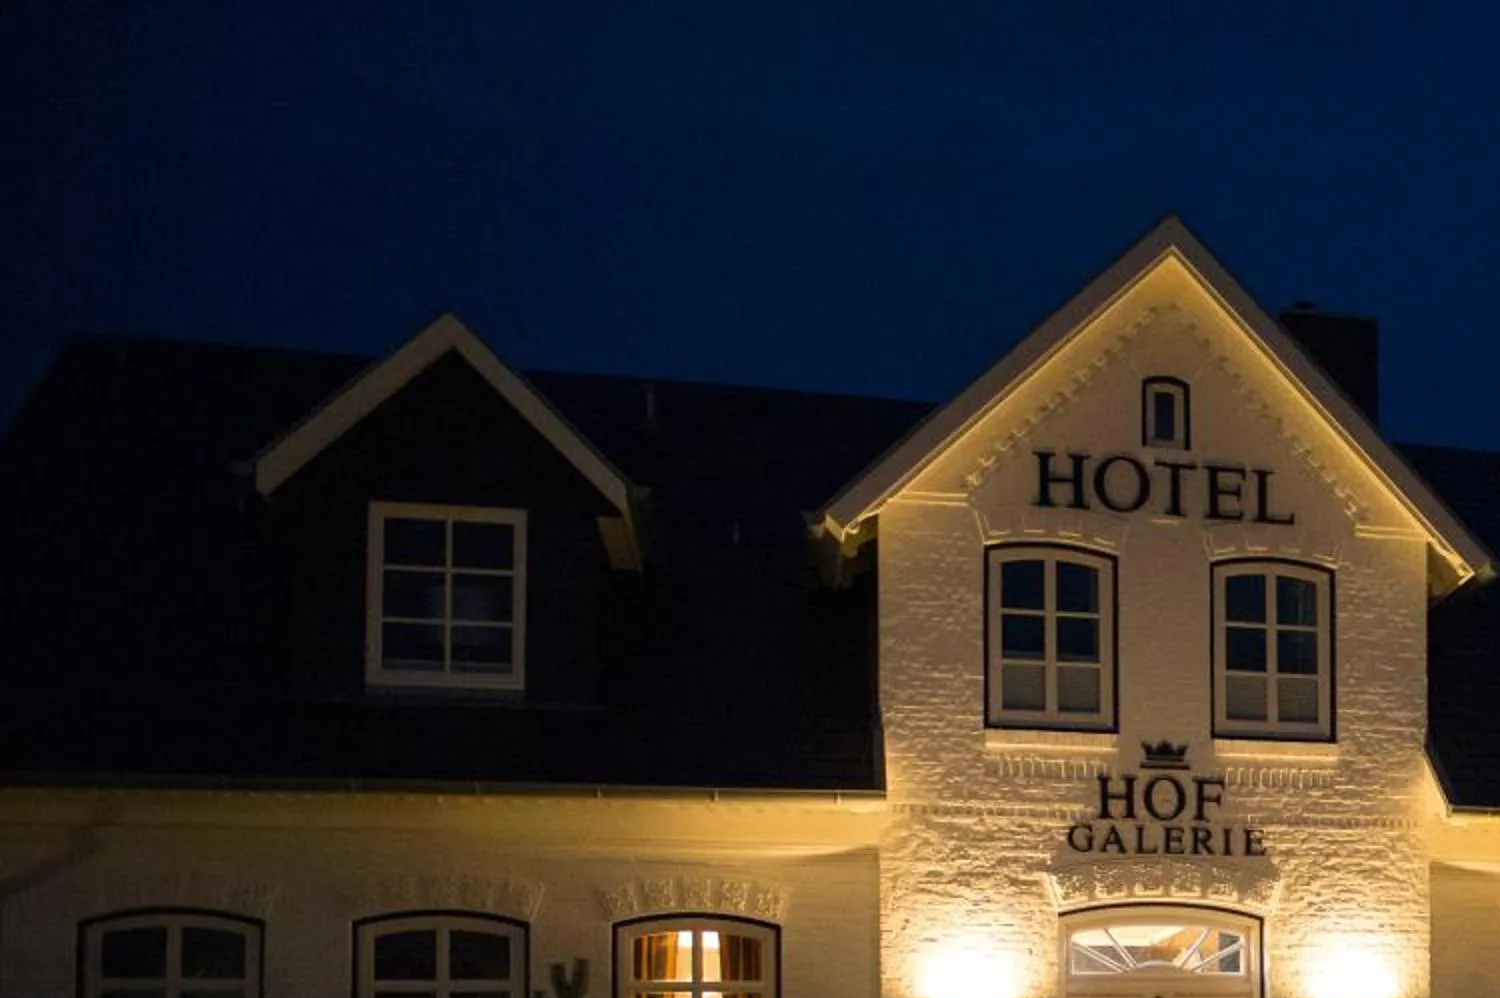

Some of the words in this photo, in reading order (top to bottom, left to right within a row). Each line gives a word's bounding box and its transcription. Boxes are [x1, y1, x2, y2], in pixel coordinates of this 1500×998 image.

[1033, 451, 1295, 525] HOTEL
[1095, 773, 1226, 822] HOF
[1066, 823, 1267, 857] GALERIE
